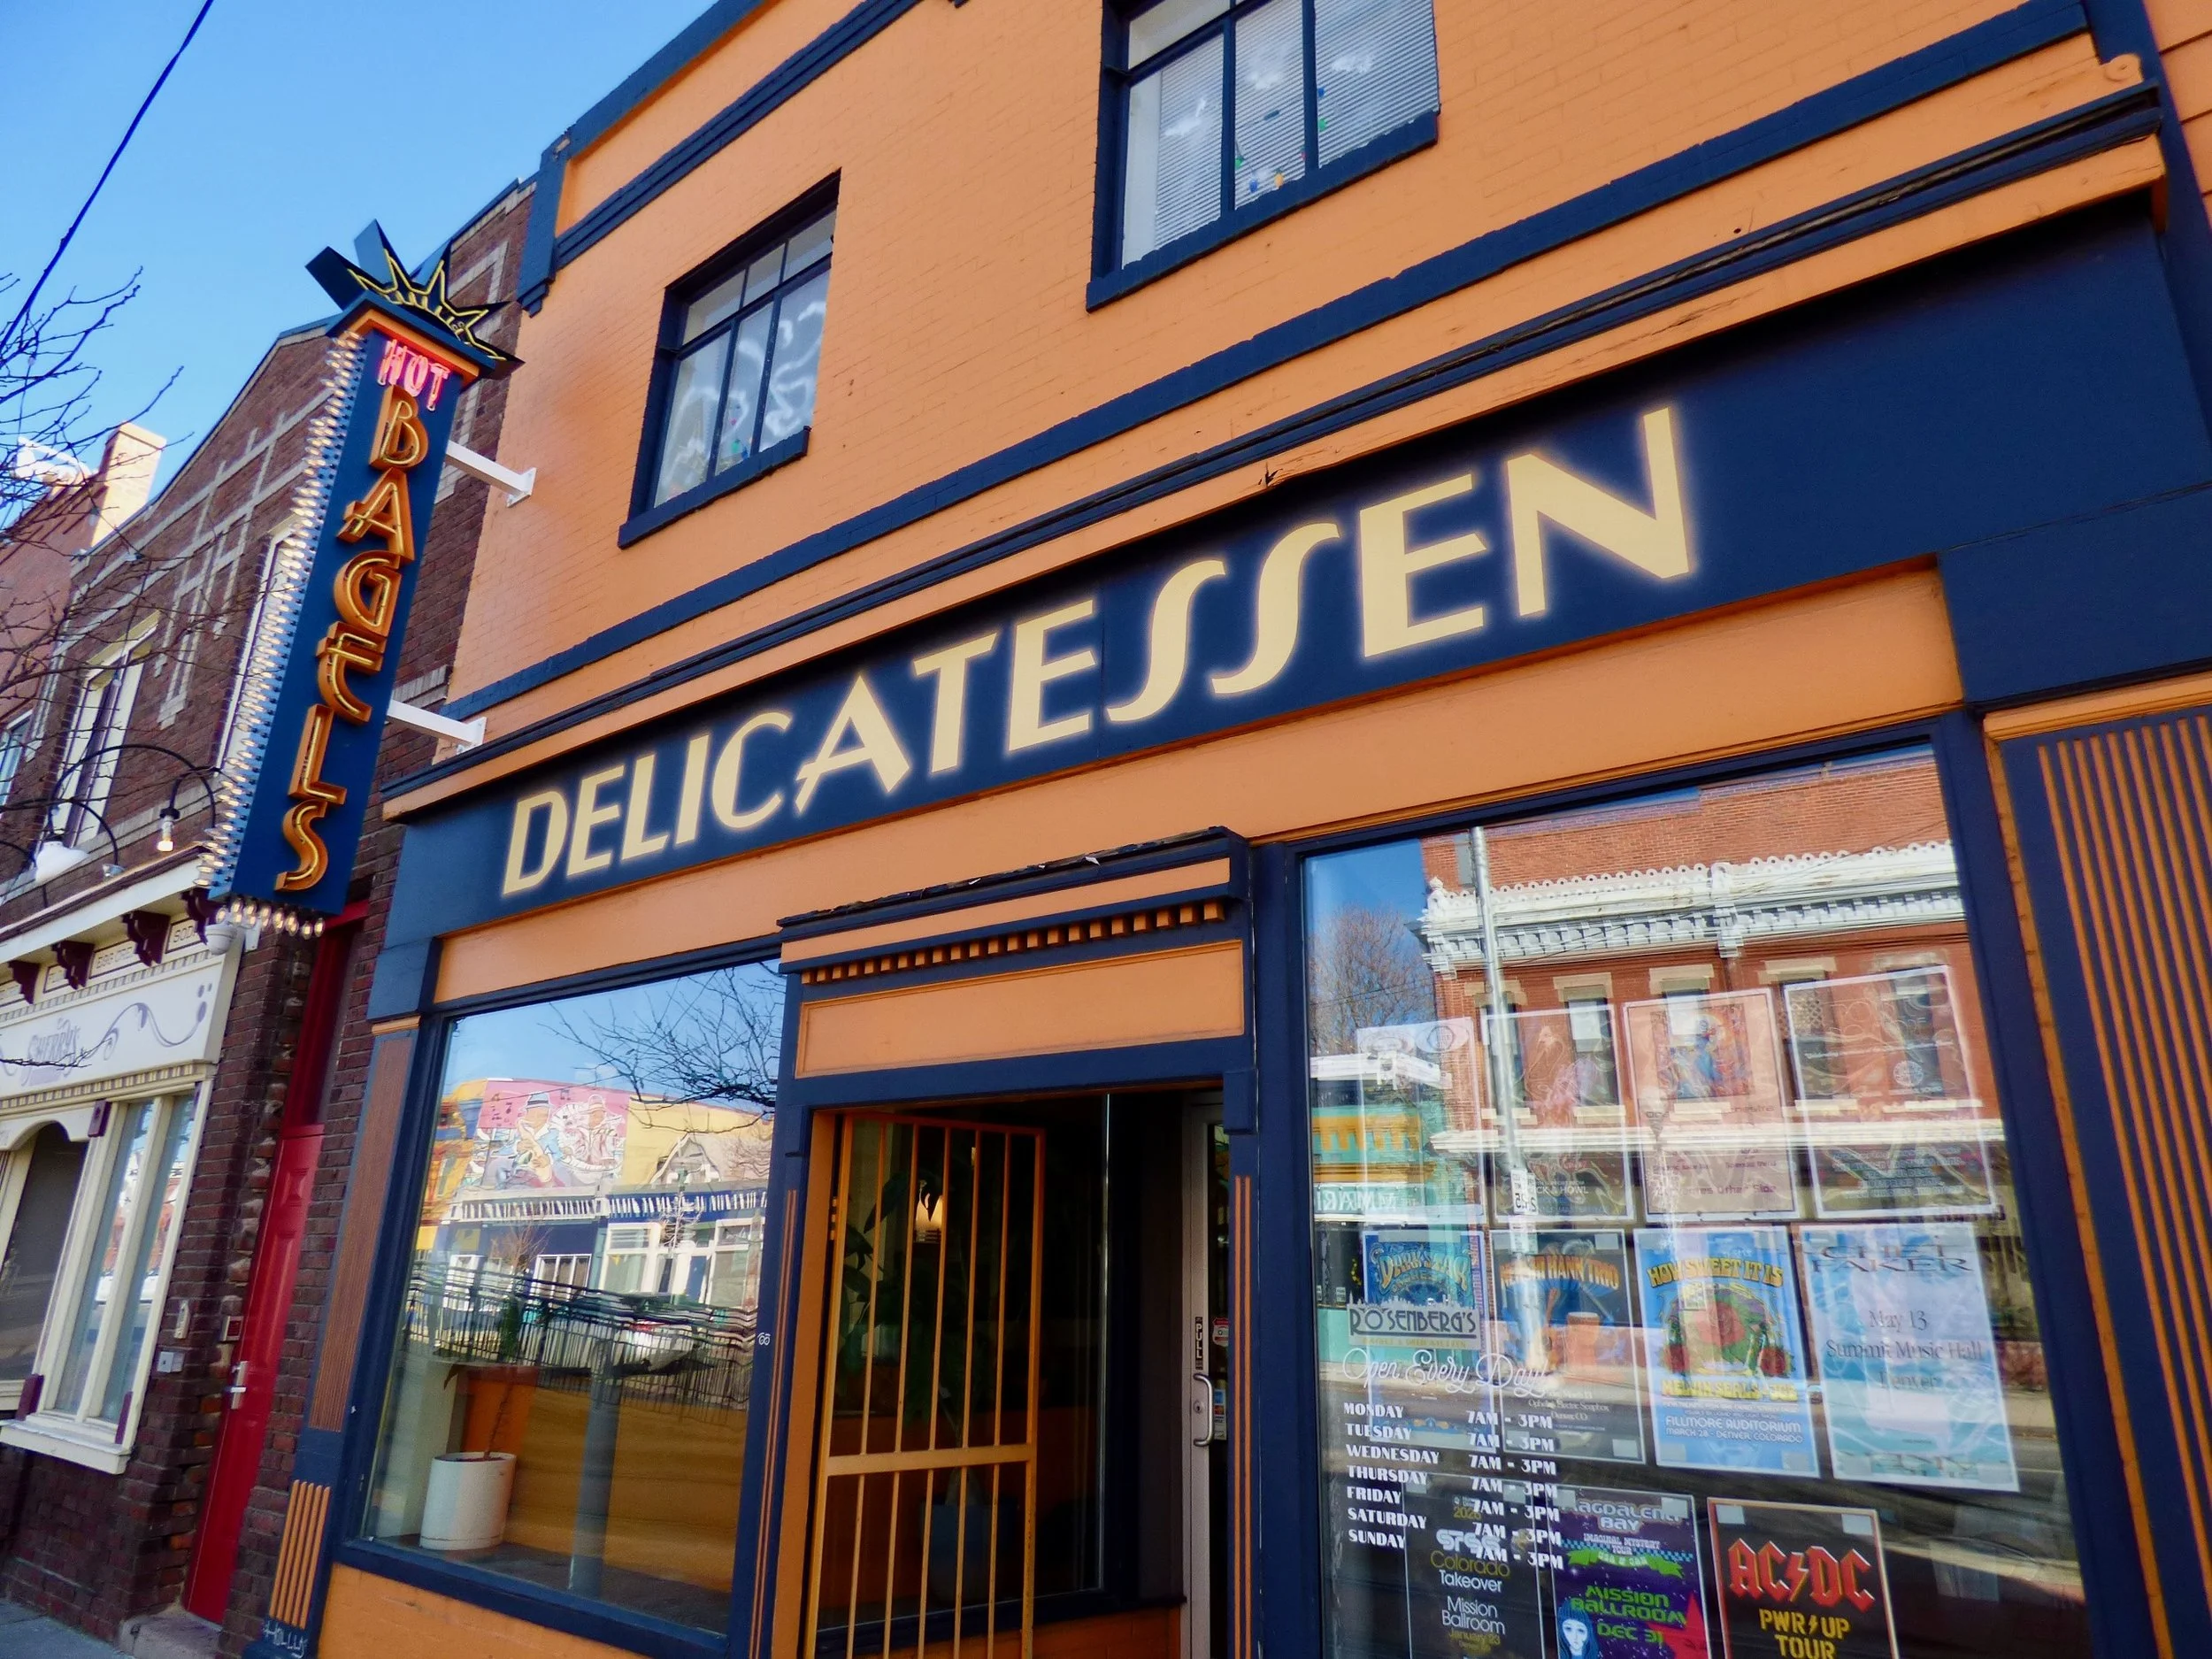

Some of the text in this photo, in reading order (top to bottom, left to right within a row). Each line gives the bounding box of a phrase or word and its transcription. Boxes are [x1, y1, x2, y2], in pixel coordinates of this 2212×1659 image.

[378, 339, 451, 411] HOT
[275, 382, 428, 892] BAGELS
[502, 406, 1691, 895] DELICATESSEN
[1647, 1256, 1785, 1288] HOW SWEET IT IS
[1349, 1309, 1477, 1336] ROSENBERG'S
[1868, 1310, 1928, 1333] May 13
[1825, 1339, 1984, 1361] Summit Music Hall
[1342, 1348, 1401, 1389] Open
[1405, 1348, 1476, 1394] Every
[1343, 1402, 1404, 1418] MONDAY
[1466, 1410, 1499, 1425] 7AM
[1517, 1414, 1553, 1430] 3PM
[1665, 1416, 1801, 1433] FILLMORE AUDITORIUM
[1345, 1423, 1413, 1441] TUESDAY
[1467, 1432, 1500, 1448] 7AM
[1519, 1436, 1555, 1452] 3PM
[1665, 1427, 1696, 1437] MARCH
[1753, 1432, 1804, 1444] COLORADO
[1346, 1443, 1440, 1465] WEDNESDAY
[1469, 1455, 1502, 1471] 7AM
[1521, 1459, 1556, 1476] 3PM
[1346, 1464, 1428, 1486] THURSDAY
[1470, 1477, 1502, 1493] 7AM
[1523, 1482, 1558, 1499] 3PM
[1347, 1486, 1402, 1505] FRIDAY
[1471, 1499, 1504, 1516] 7AM
[1524, 1504, 1560, 1523] 3PM
[1348, 1508, 1427, 1530] SATURDAY
[1471, 1522, 1506, 1539] 7AM
[1525, 1528, 1562, 1547] 3PM
[1348, 1530, 1406, 1549] SUNDAY
[1527, 1551, 1564, 1571] 3PM
[1611, 1544, 1633, 1555] TOUR
[1431, 1550, 1510, 1577] Colorado
[1439, 1569, 1503, 1593] Takeover
[1447, 1595, 1498, 1618] Mission
[1441, 1609, 1506, 1636] Ballroom
[1596, 1621, 1664, 1644] DEC 31
[1774, 1633, 1837, 1659] TOUR
